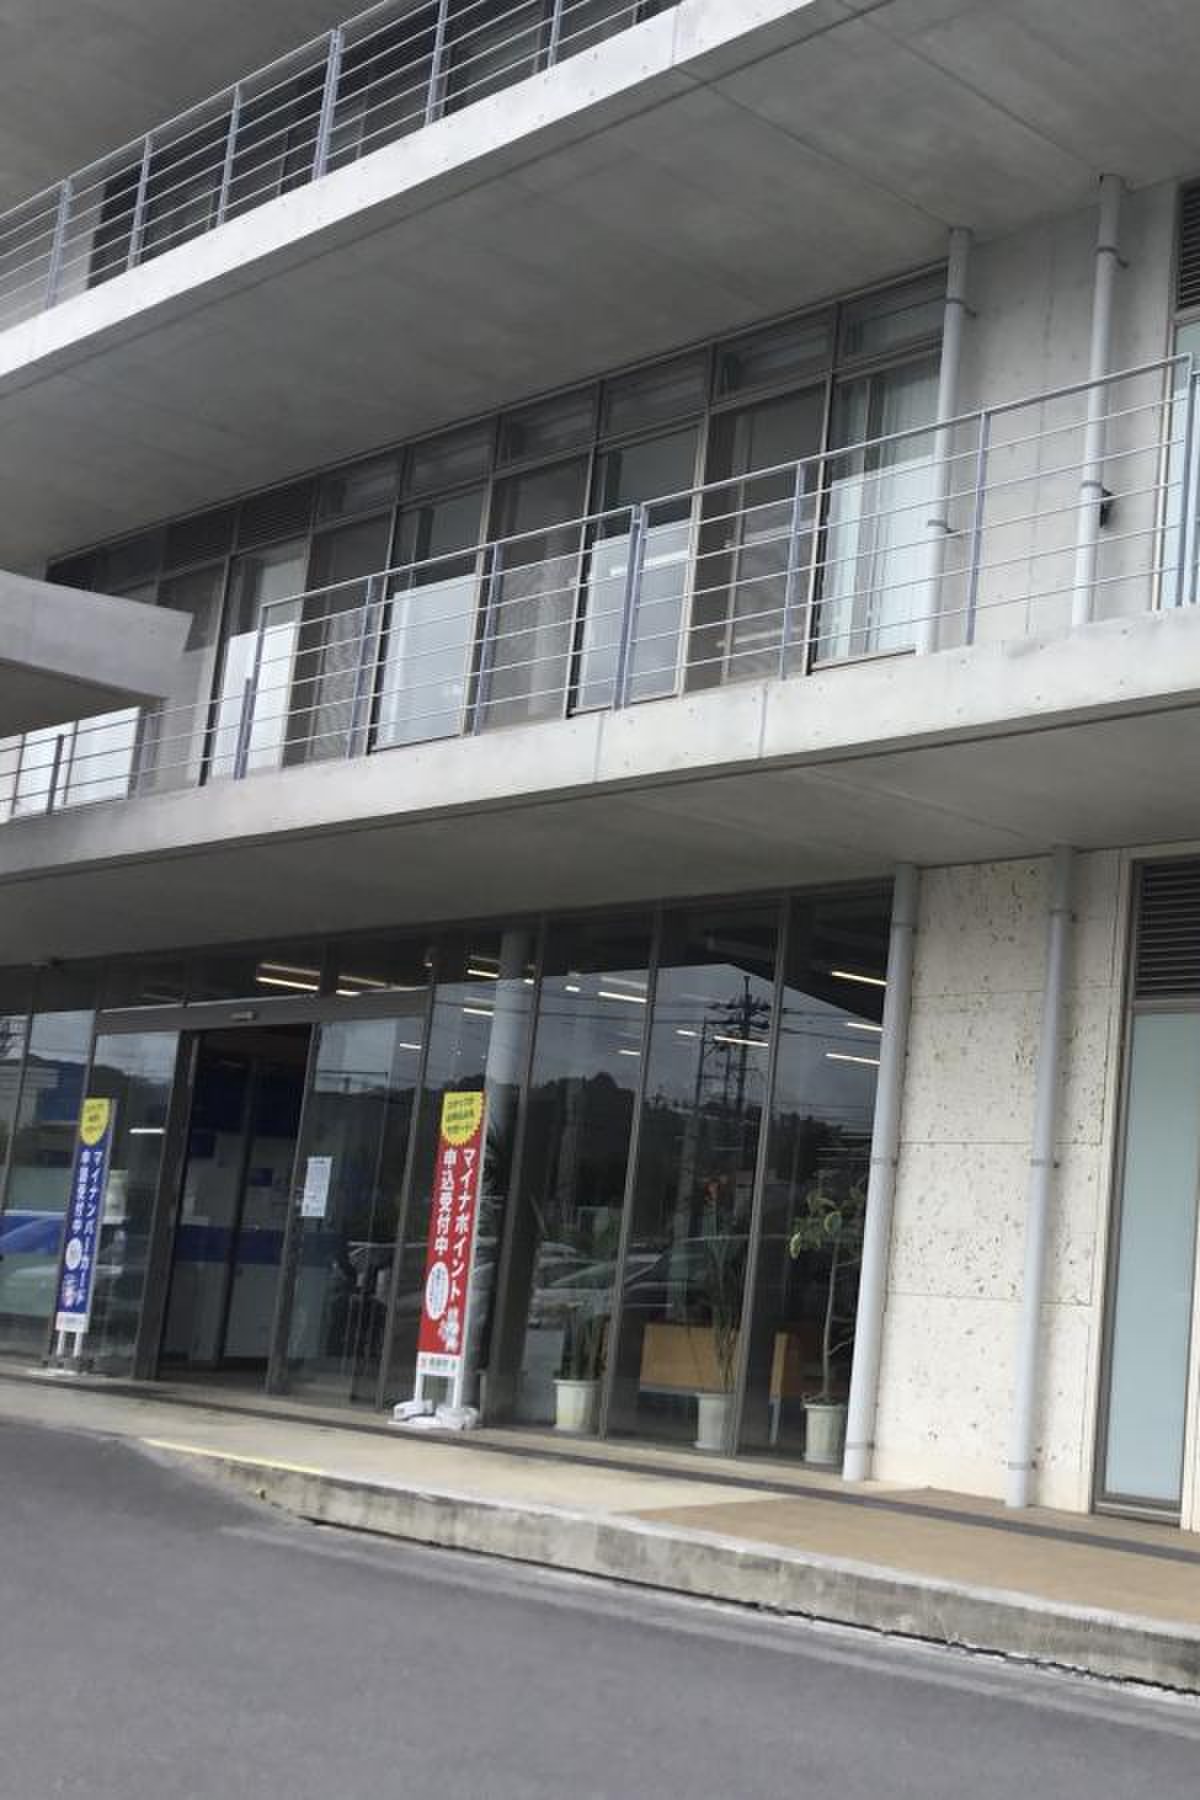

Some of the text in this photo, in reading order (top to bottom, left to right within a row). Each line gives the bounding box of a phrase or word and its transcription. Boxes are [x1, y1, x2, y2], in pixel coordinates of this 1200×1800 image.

[433, 1148, 457, 1257] 申込受付中
[451, 1148, 477, 1302] マイナポイント
